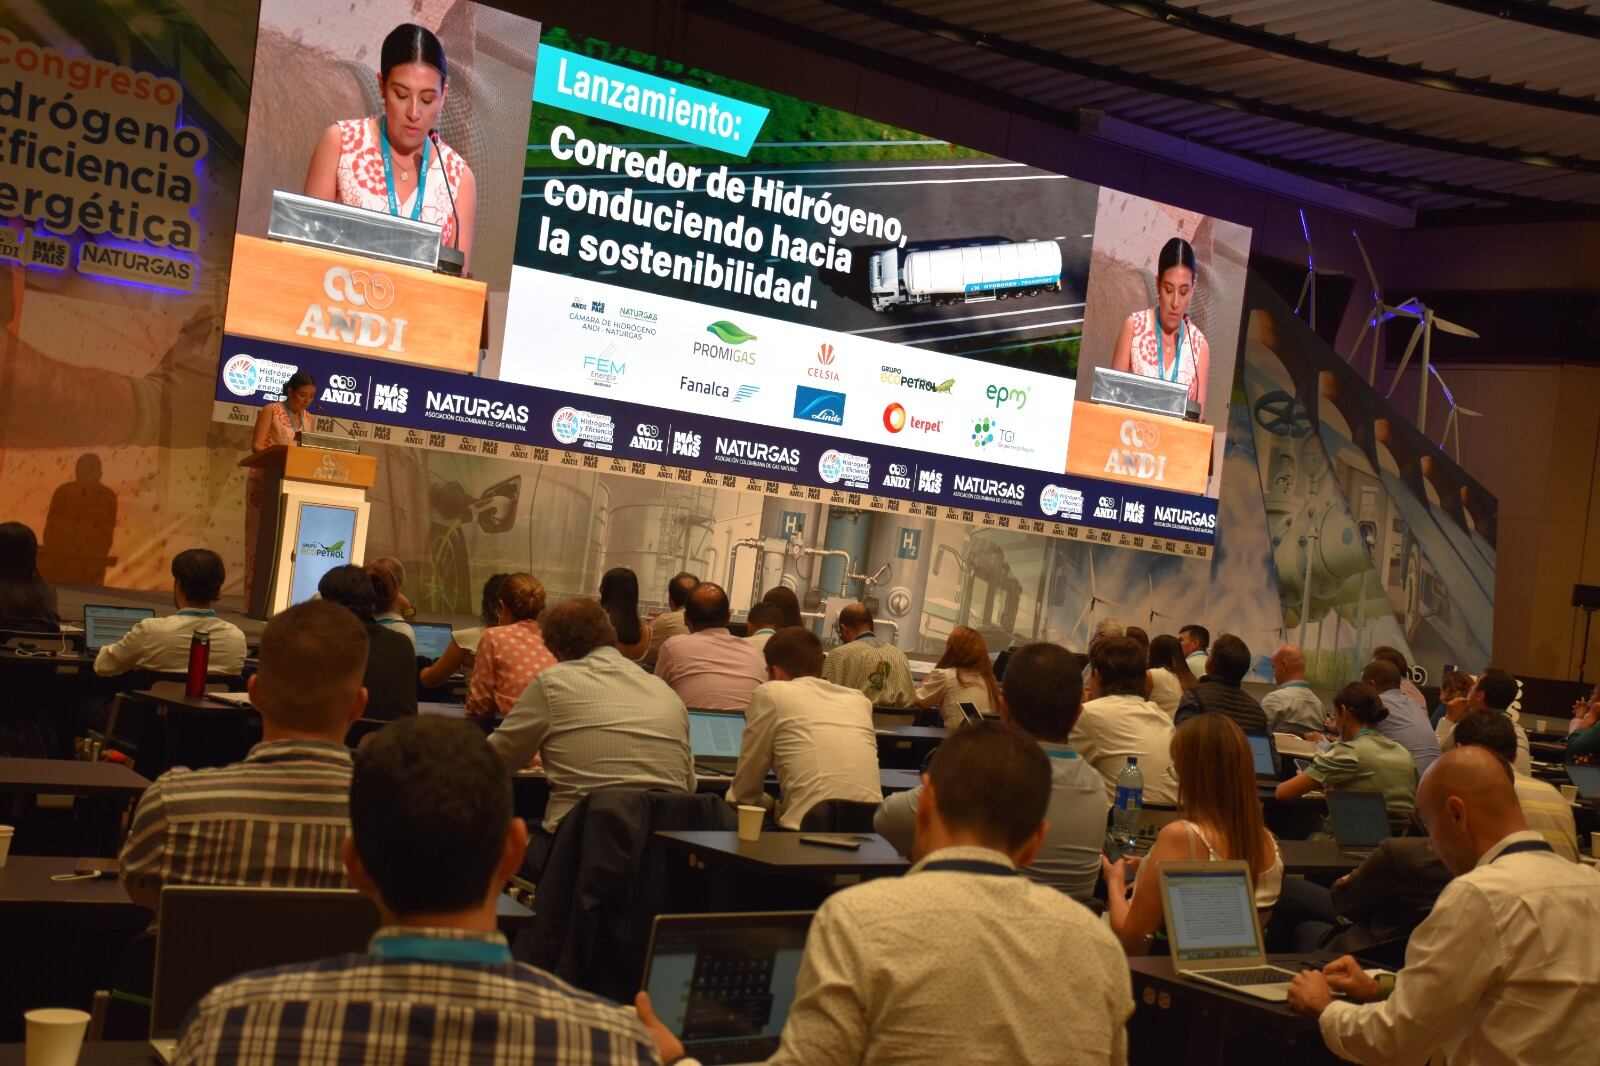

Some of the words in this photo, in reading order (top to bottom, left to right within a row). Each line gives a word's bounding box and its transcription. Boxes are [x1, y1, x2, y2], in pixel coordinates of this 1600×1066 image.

[557, 58, 741, 140] Lanzamiento:
[550, 125, 702, 192] Corredor
[706, 166, 745, 203] de
[752, 176, 907, 248] Hidrógeno,
[544, 179, 763, 252] conduciendo
[771, 225, 852, 273] hacia
[34, 240, 66, 254] MÁS
[32, 250, 64, 266] PAÍS
[83, 245, 190, 279] NATURGAS
[539, 216, 570, 256] la
[579, 234, 817, 309] sostenibilidad.
[620, 307, 658, 321] NATURGAS
[296, 303, 408, 352] ANDI
[570, 312, 600, 324] CÁMARA
[602, 318, 612, 326] DE
[614, 321, 657, 335] HIDRÓGENO
[606, 328, 643, 341] NATURGAS
[693, 342, 756, 365] PROMIGAS
[584, 355, 626, 376] FEM
[881, 366, 901, 374] GRUPO
[808, 368, 840, 381] CELSIA
[375, 384, 408, 401] MÁS
[680, 376, 730, 398] Fanalca
[320, 388, 362, 406] ANDI
[374, 396, 407, 413] PAÍS
[986, 384, 1026, 410] epm
[426, 390, 529, 424] NATURGAS
[425, 411, 454, 421] ASOCIACIÓN
[812, 409, 842, 423] Linde
[910, 416, 941, 433] terpel
[629, 436, 663, 452] ANDI
[674, 430, 701, 446] MÁS
[1000, 429, 1015, 443] TGI
[458, 444, 476, 452] ANDI
[672, 442, 700, 458] PAÍS
[715, 436, 800, 466] NATURGAS
[1104, 448, 1167, 480] ANDI
[882, 474, 911, 489] ANDI
[920, 470, 942, 482] MÁS
[918, 480, 942, 494] PAÍS
[954, 474, 1025, 500] NATURGAS
[1093, 507, 1117, 520] ANDI
[1125, 502, 1145, 514] MÁS
[1124, 511, 1144, 524] PAÍS
[1154, 506, 1216, 528] NATURGAS
